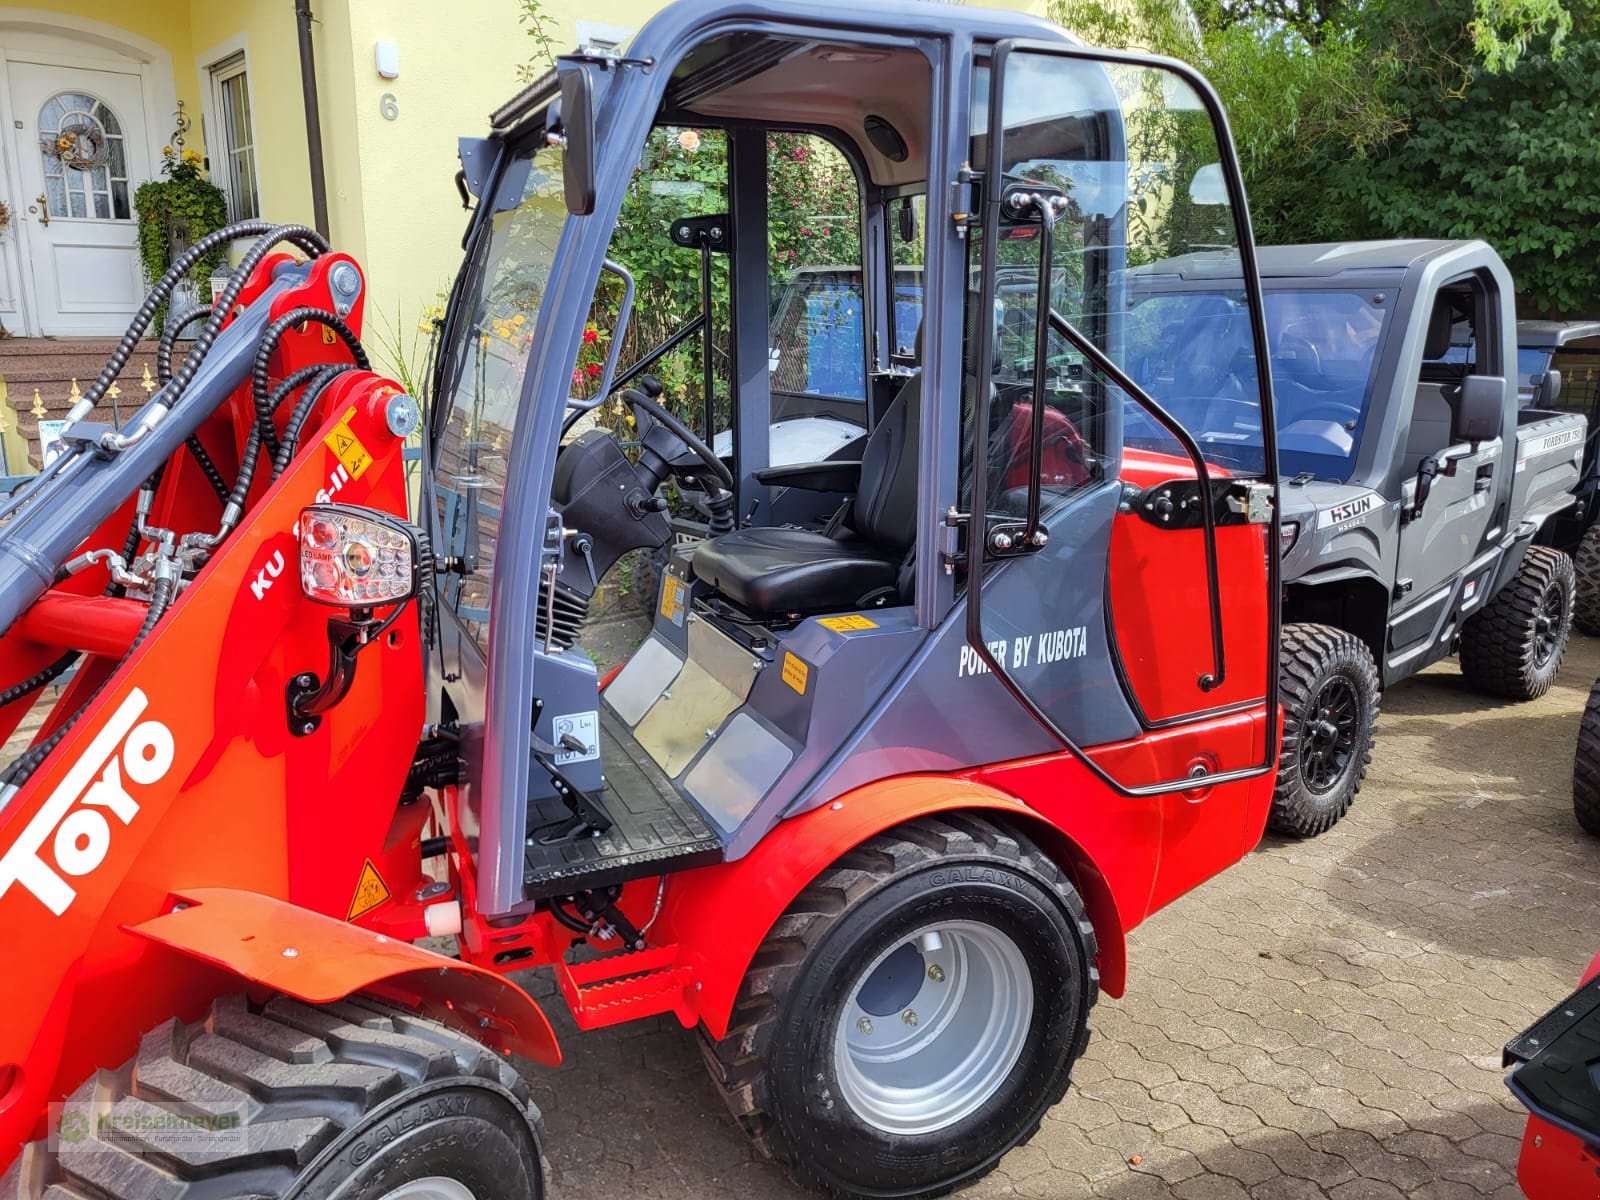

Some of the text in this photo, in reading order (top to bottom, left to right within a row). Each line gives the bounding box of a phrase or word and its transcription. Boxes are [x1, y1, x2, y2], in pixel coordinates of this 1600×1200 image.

[380, 93, 398, 121] 6
[250, 549, 285, 601] KU
[1013, 636, 1032, 669] BY
[1037, 626, 1087, 664] KUBOTA
[929, 867, 1027, 890] GALAXY
[350, 1095, 472, 1167] GALAXY
